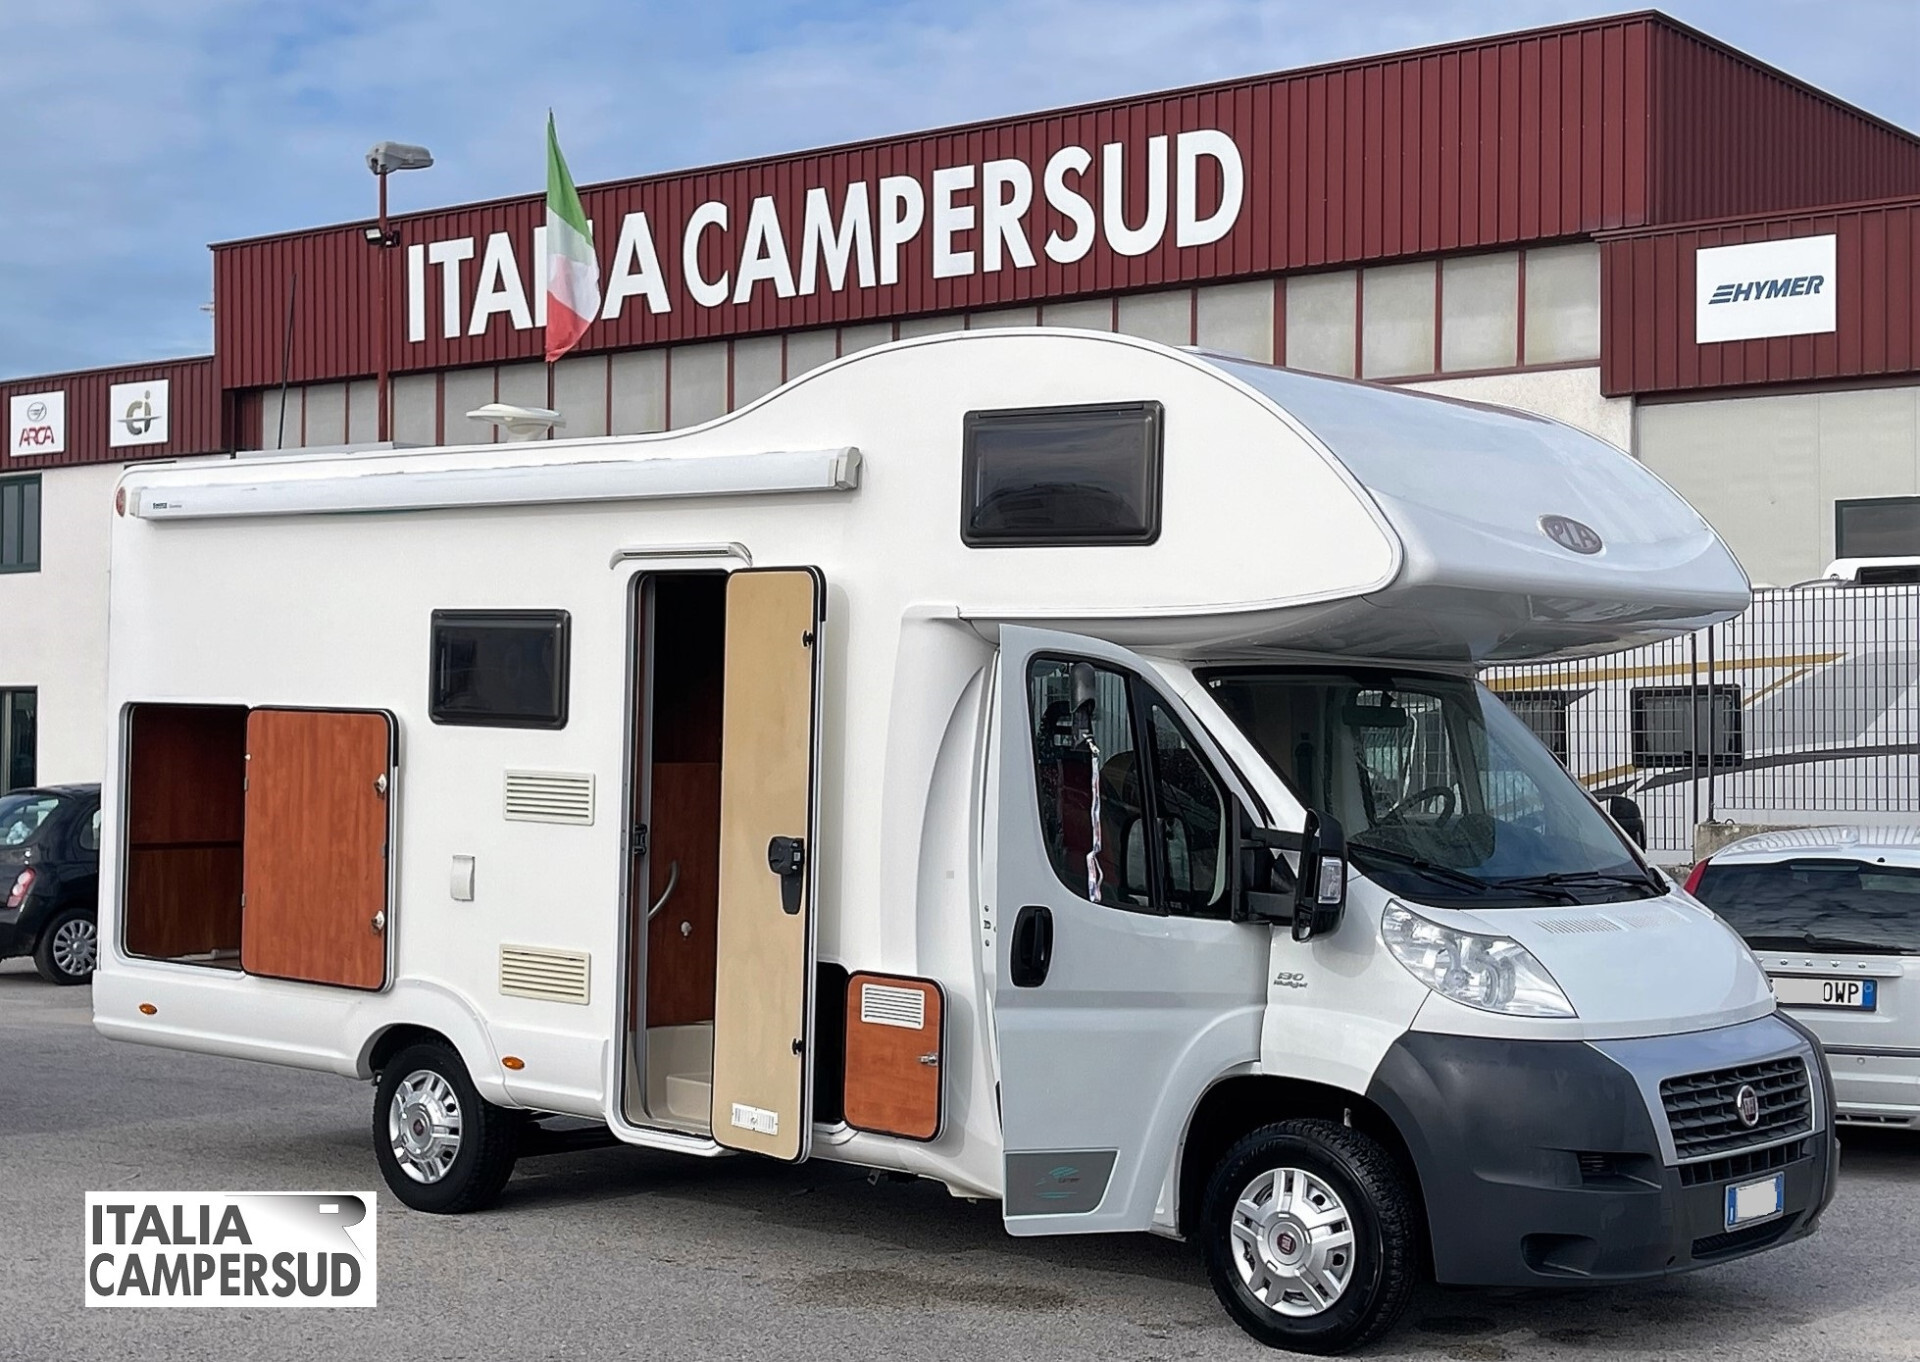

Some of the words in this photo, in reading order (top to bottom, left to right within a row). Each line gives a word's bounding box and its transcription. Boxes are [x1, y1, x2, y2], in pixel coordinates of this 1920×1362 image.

[408, 211, 671, 343] ITAA
[683, 129, 1244, 308] CAMPERSUD
[1732, 275, 1824, 302] HYMER
[19, 426, 55, 447] ARCA
